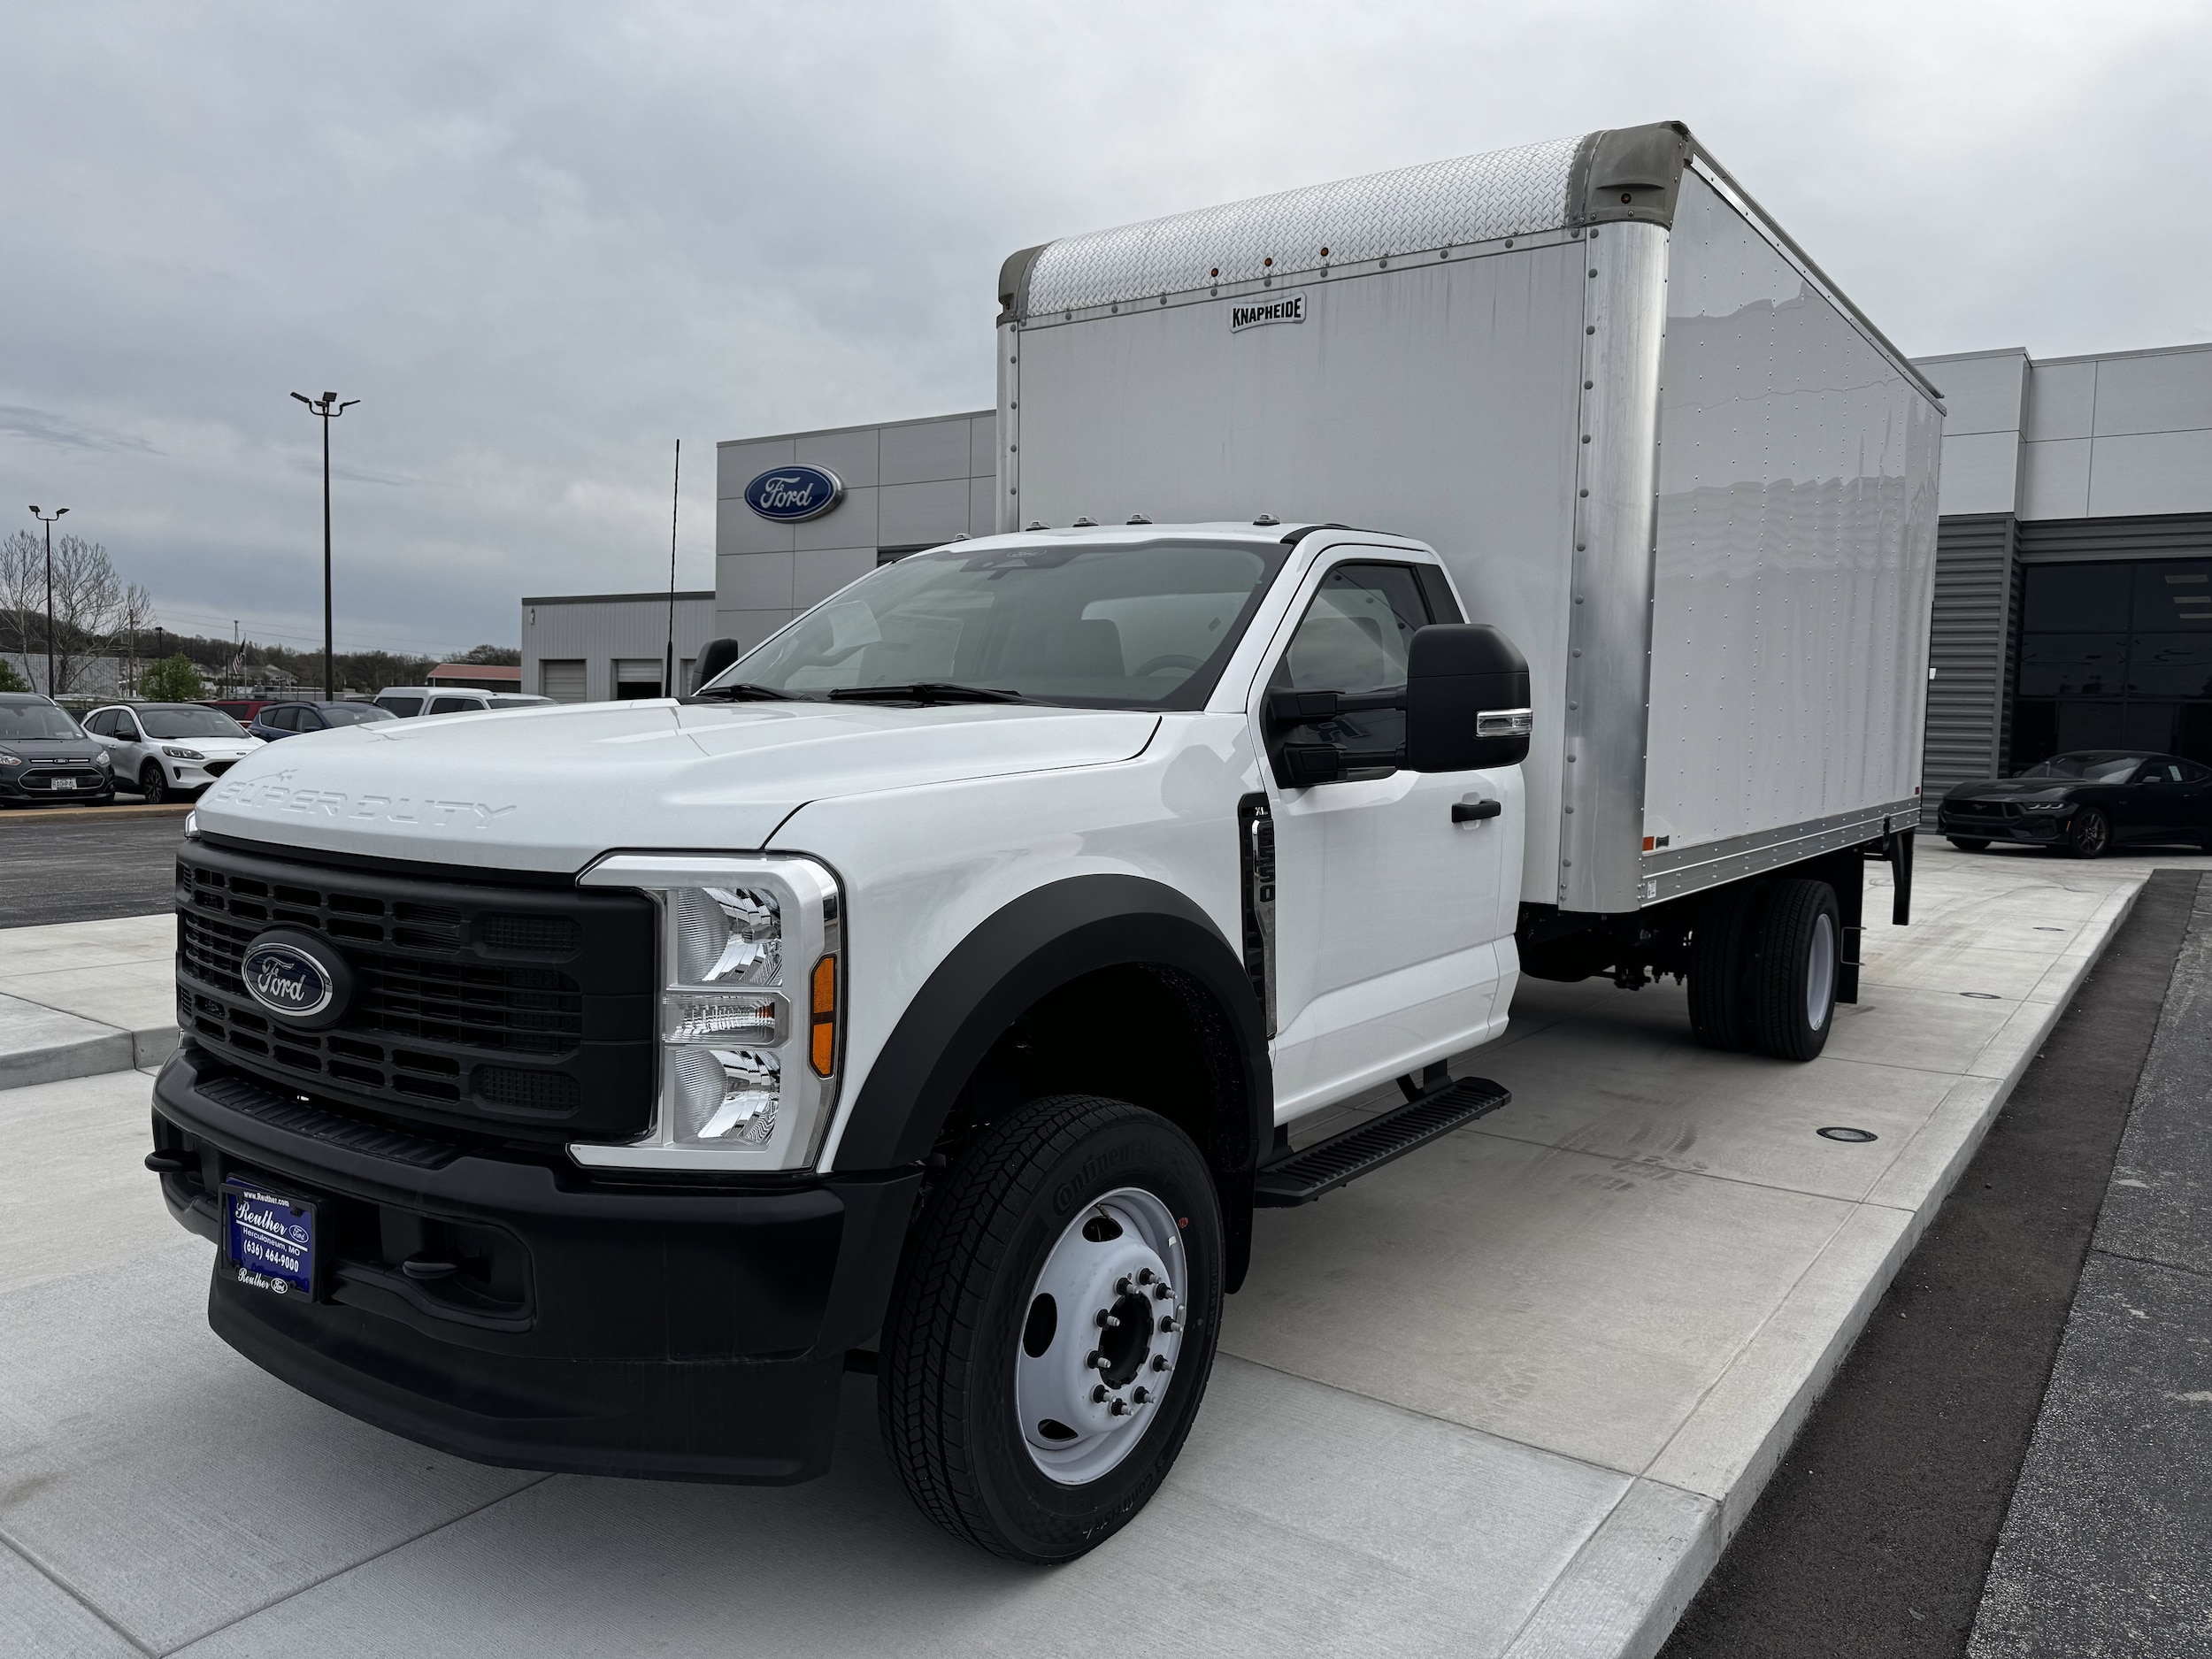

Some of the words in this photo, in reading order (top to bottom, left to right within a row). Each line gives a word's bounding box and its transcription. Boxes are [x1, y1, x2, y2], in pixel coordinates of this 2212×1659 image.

[1233, 297, 1302, 328] KNAPHEIDE
[759, 477, 814, 509] Ford
[213, 780, 348, 817] SUPER
[348, 794, 518, 830] DUTY
[257, 956, 307, 1002] Ford
[243, 1191, 290, 1208] www.Reuther.com
[234, 1201, 288, 1235] Reuther
[243, 1239, 264, 1261] (636)
[265, 1248, 299, 1272] 464-9000
[288, 1245, 301, 1256] MO
[237, 1267, 270, 1290] Reuther
